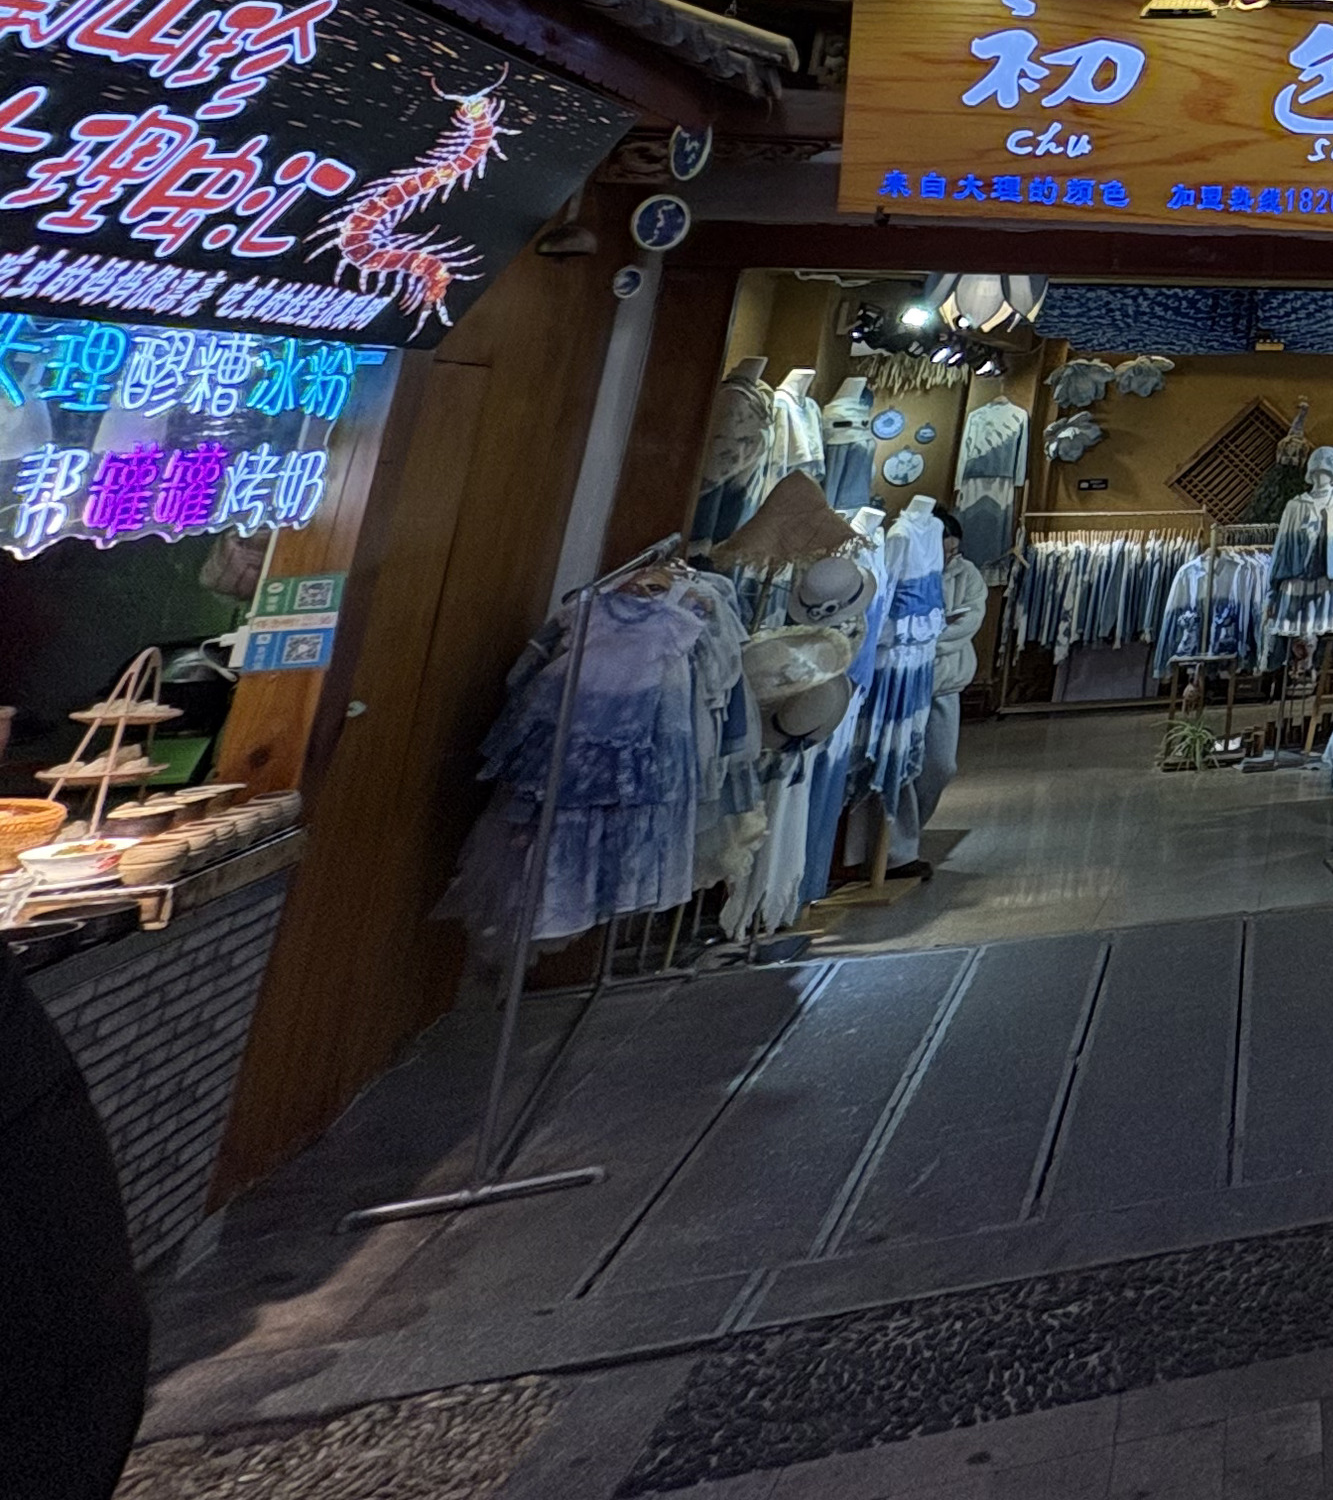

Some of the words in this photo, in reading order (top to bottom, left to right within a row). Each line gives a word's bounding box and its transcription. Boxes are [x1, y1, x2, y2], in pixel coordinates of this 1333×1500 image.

[878, 169, 1130, 209] 来自大理的颜色
